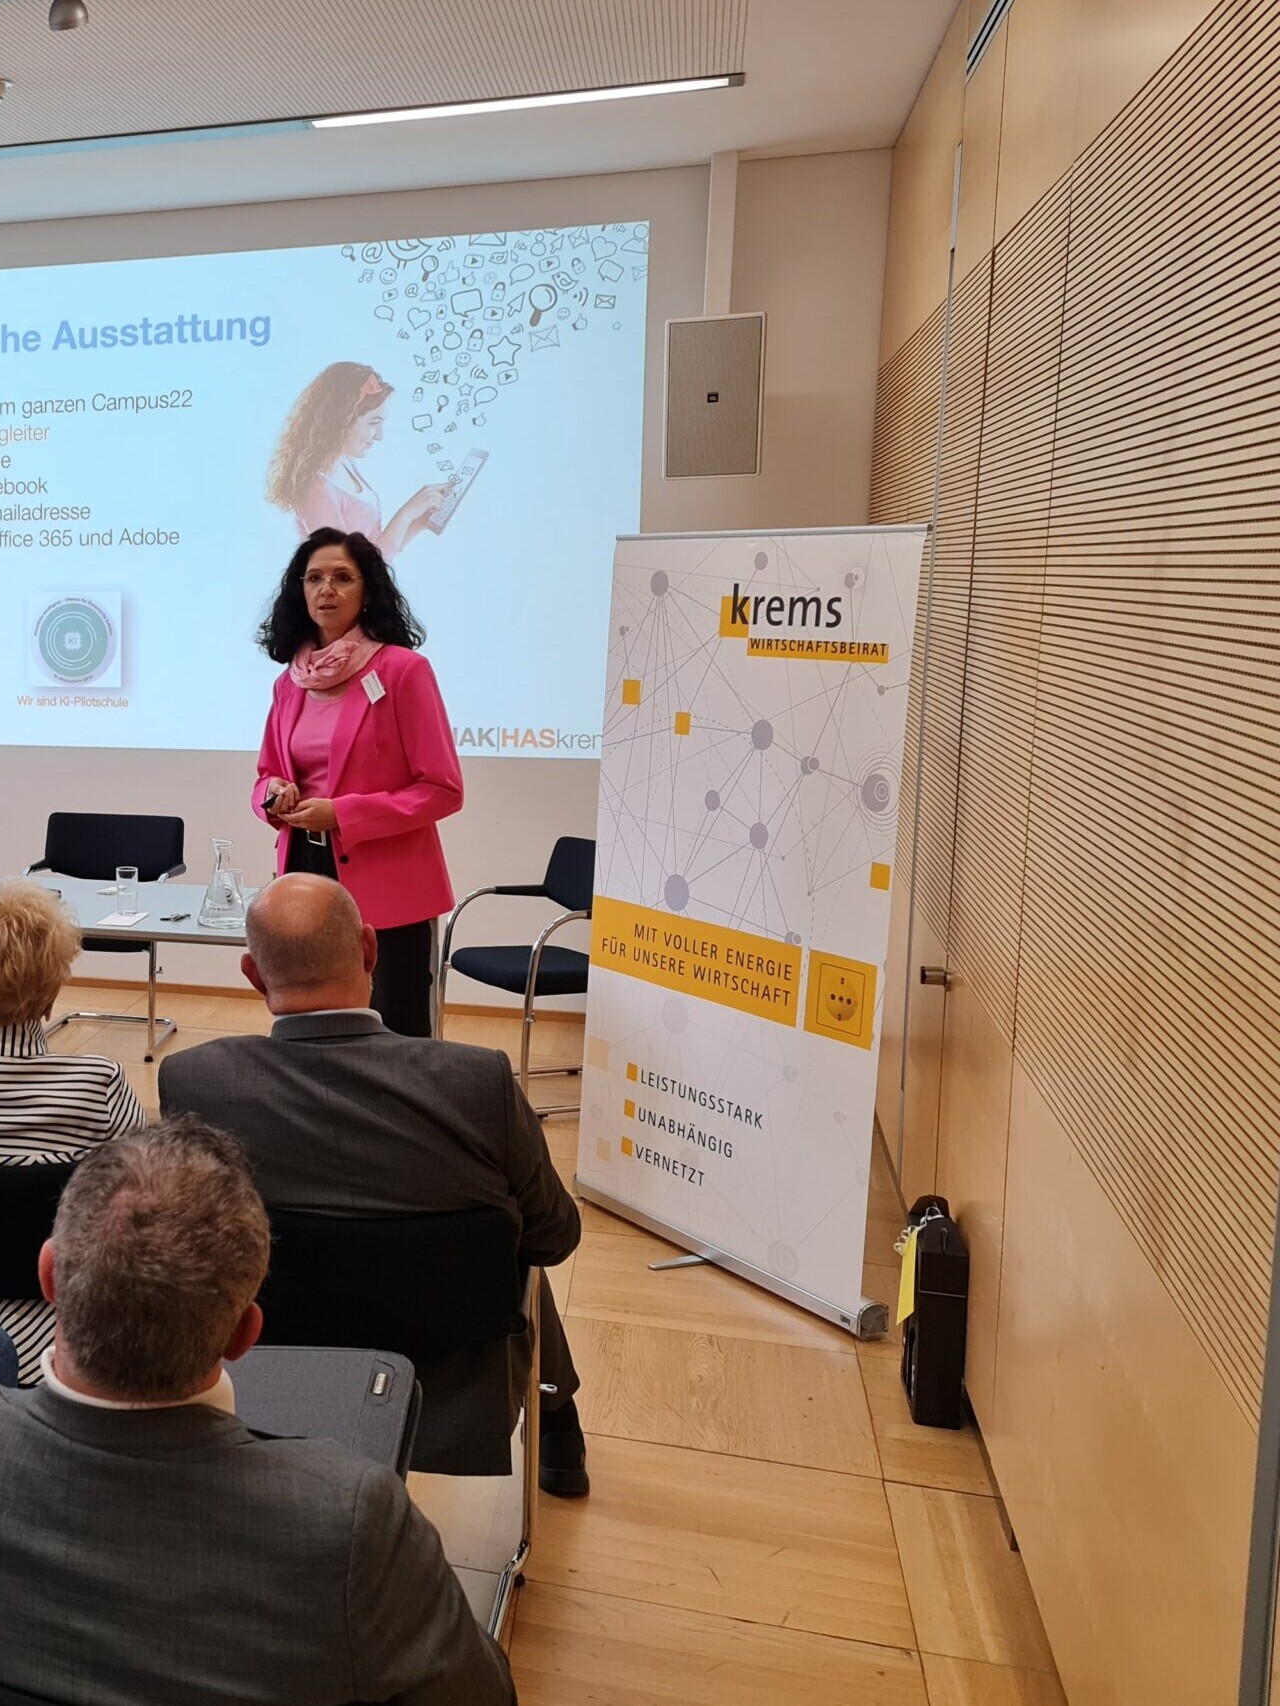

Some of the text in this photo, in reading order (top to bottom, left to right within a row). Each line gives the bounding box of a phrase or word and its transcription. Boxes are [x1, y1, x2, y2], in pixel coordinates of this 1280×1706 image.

[51, 314, 271, 351] Ausstattung
[21, 398, 86, 419] ganzen
[92, 389, 193, 413] Campus22
[38, 529, 73, 547] 365
[79, 528, 113, 547] und
[119, 527, 180, 546] Adobe
[730, 583, 842, 628] krems
[750, 638, 887, 657] WIRTSCHAFTSBEIRAT
[16, 695, 33, 706] Wir
[37, 696, 57, 707] sind
[601, 935, 792, 1007] FÜR UNSERE WIRTSCHAFT
[634, 923, 793, 981] MIT VOLLER ENERGIE
[640, 1069, 764, 1130] LEISTUNGSSTARK
[638, 1106, 733, 1158] UNABHÄNGIG
[635, 1144, 705, 1187] VERNETZT
